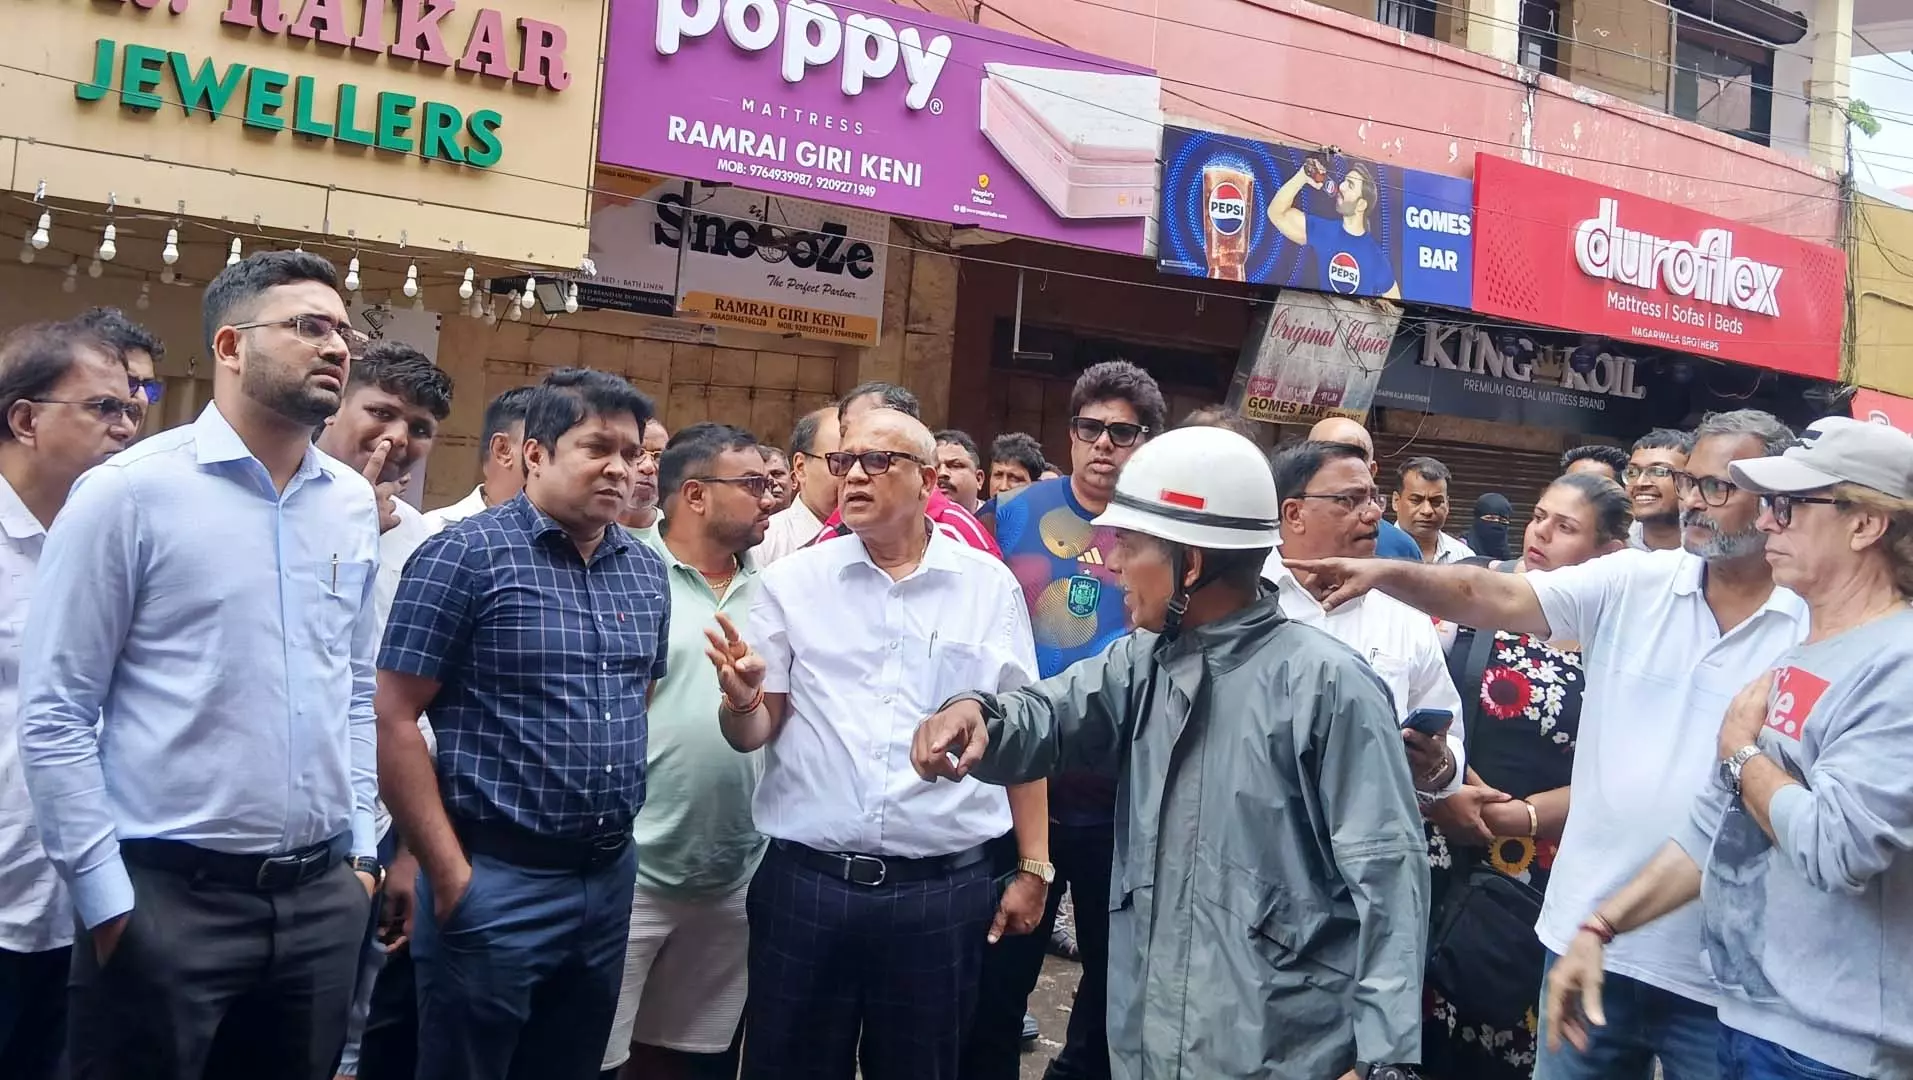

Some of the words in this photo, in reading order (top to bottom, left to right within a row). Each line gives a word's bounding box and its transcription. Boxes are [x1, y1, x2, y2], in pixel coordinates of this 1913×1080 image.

[655, 0, 952, 111] poppy
[75, 38, 504, 168] JEWELLERS
[741, 97, 865, 136] MATTRESS
[667, 115, 786, 163] RAMRAI
[795, 139, 853, 174] GIRI
[860, 152, 922, 188] KENI
[717, 158, 747, 176] MOB:
[749, 161, 813, 189] 9764939987,
[815, 172, 877, 199] 9209271949
[1210, 201, 1244, 217] PEPSI
[1405, 205, 1471, 237] GOMES
[1331, 265, 1359, 283] PEPSI
[1418, 245, 1459, 273] BAR
[1575, 198, 1784, 318] duroflex
[766, 274, 784, 288] The
[787, 278, 821, 295] Perfect
[714, 297, 774, 319] RAMRAI
[778, 307, 809, 323] GIRI
[811, 311, 847, 329] KENI
[1607, 289, 1662, 318] Mattress
[1672, 304, 1705, 328] Sofas
[1715, 312, 1744, 335] Beds
[1270, 307, 1342, 356] Original
[1346, 319, 1391, 356] Choice
[1631, 325, 1680, 344] NAGARWALA
[1682, 335, 1720, 352] BROTHERS
[1420, 321, 1533, 383] KING
[1560, 346, 1647, 400] KOIL
[1247, 396, 1297, 415] GOMES
[1299, 403, 1326, 417] BAR
[1463, 378, 1503, 396] PREMIUM
[1505, 383, 1537, 402] GLOBAL
[1538, 389, 1578, 407] MATTRESS
[1579, 396, 1606, 411] BRAND
